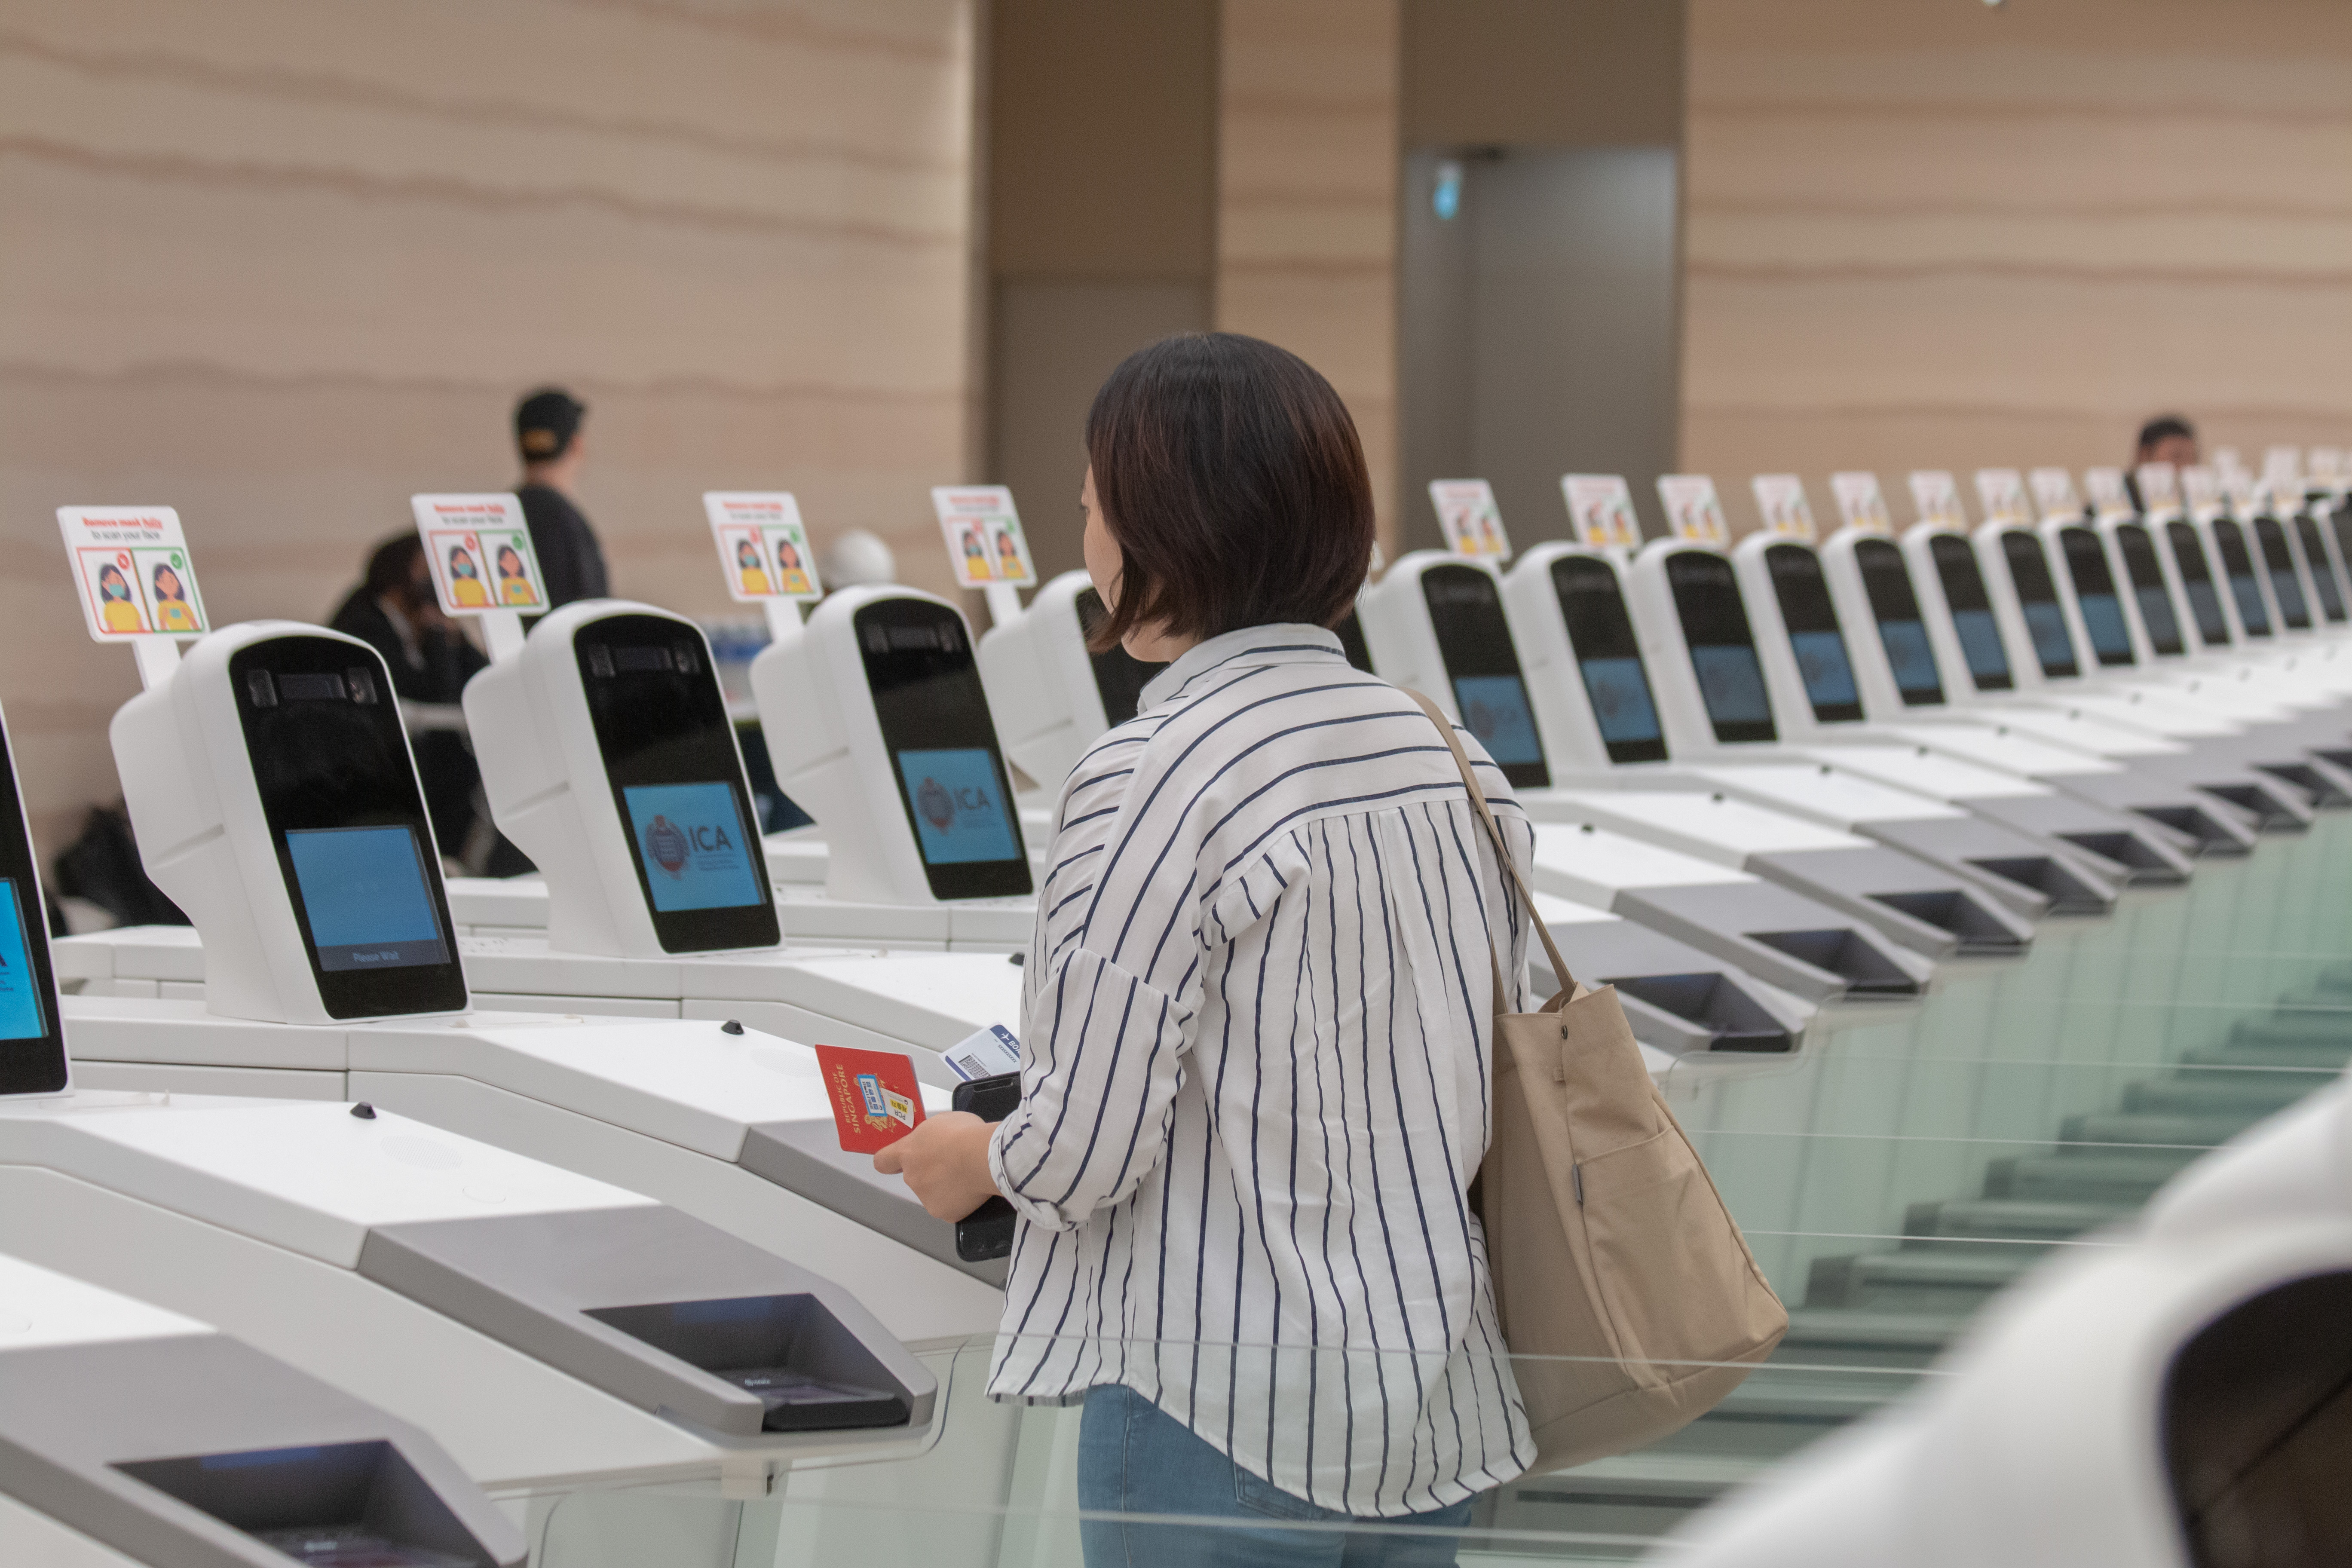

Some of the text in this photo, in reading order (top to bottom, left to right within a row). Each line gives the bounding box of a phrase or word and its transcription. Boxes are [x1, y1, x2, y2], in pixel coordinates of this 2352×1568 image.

[101, 532, 121, 540] scan
[122, 532, 140, 542] your
[141, 530, 161, 540] face
[953, 786, 990, 812] ICA
[689, 825, 732, 852] ICA
[353, 951, 399, 962] Please Wait
[833, 1072, 851, 1123] REPUBLIC OF
[836, 1064, 861, 1133] SINGAPORE
[894, 1109, 906, 1121] PCR
